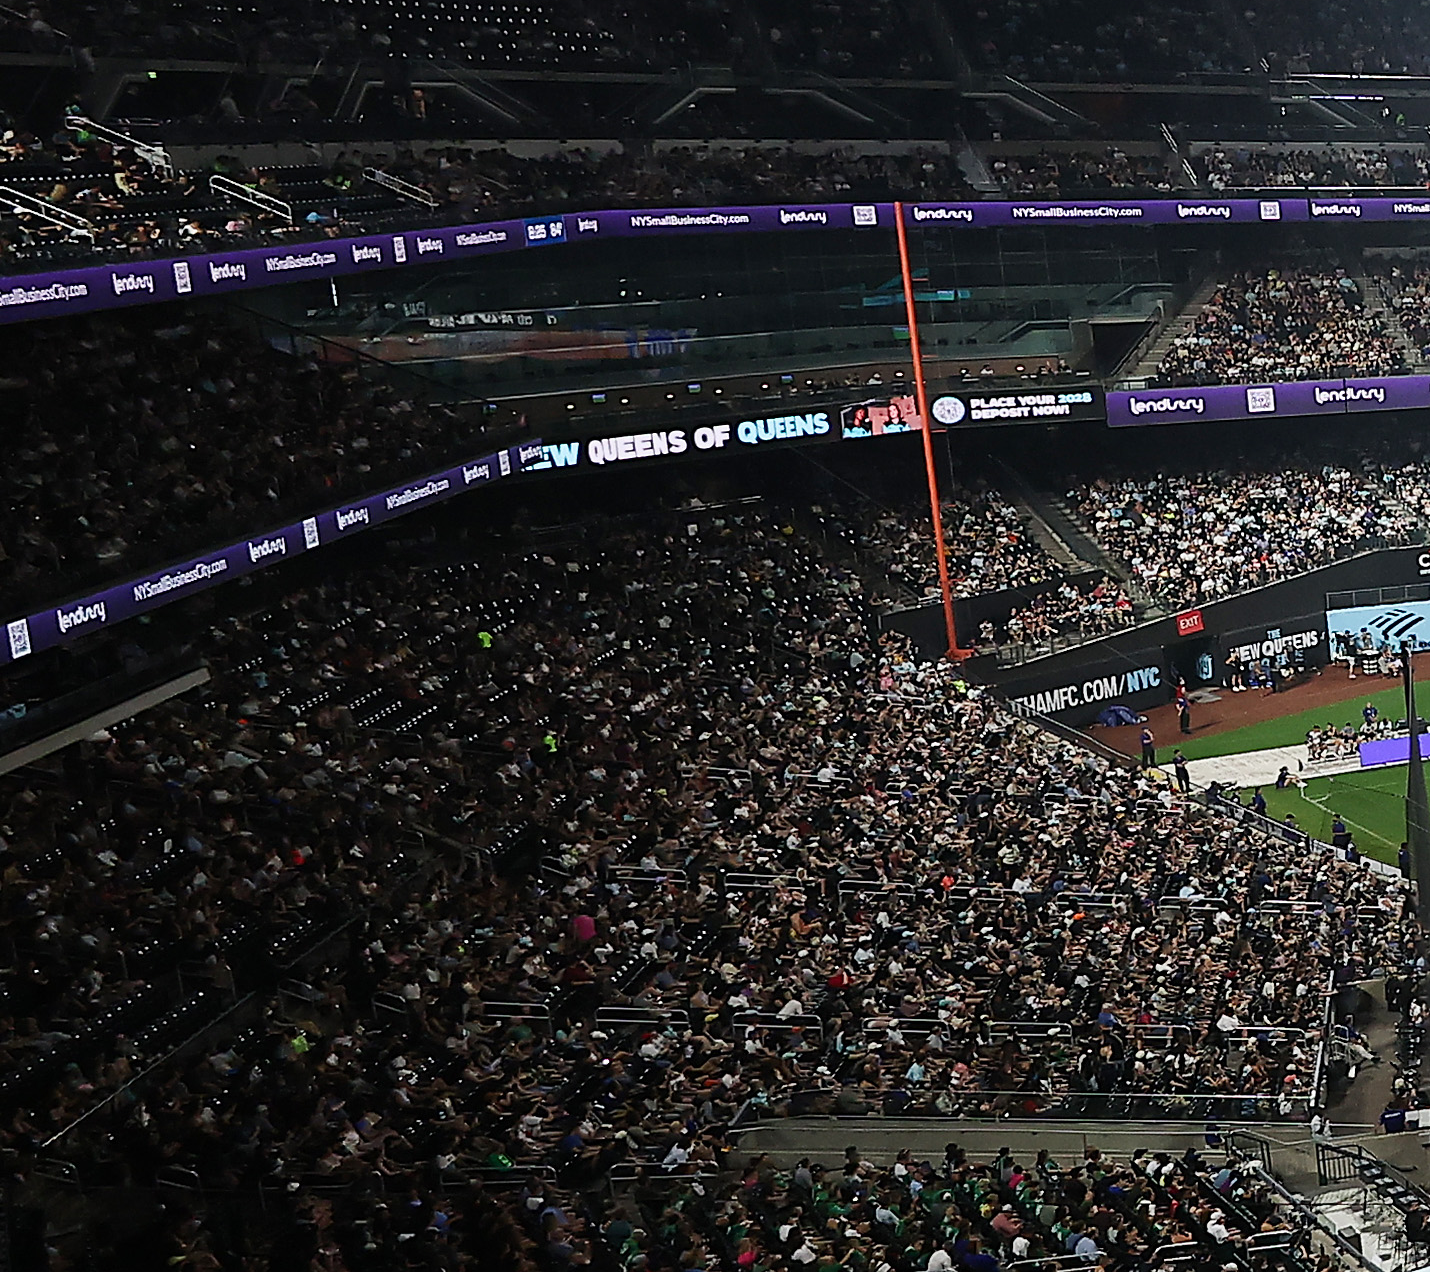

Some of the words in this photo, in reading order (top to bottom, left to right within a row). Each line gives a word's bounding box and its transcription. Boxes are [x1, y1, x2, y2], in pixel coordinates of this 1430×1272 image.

[970, 396, 1010, 410] PLACE
[1012, 394, 1056, 408] YOUR
[1129, 394, 1205, 417] lendistry
[970, 405, 1026, 420] DEPOSIT
[1028, 404, 1071, 417] NOW!
[587, 430, 688, 466] QUEENS
[693, 423, 730, 450] OF
[736, 412, 830, 445] QUEENS
[1179, 614, 1200, 629] EXIT
[1267, 629, 1281, 640] THE
